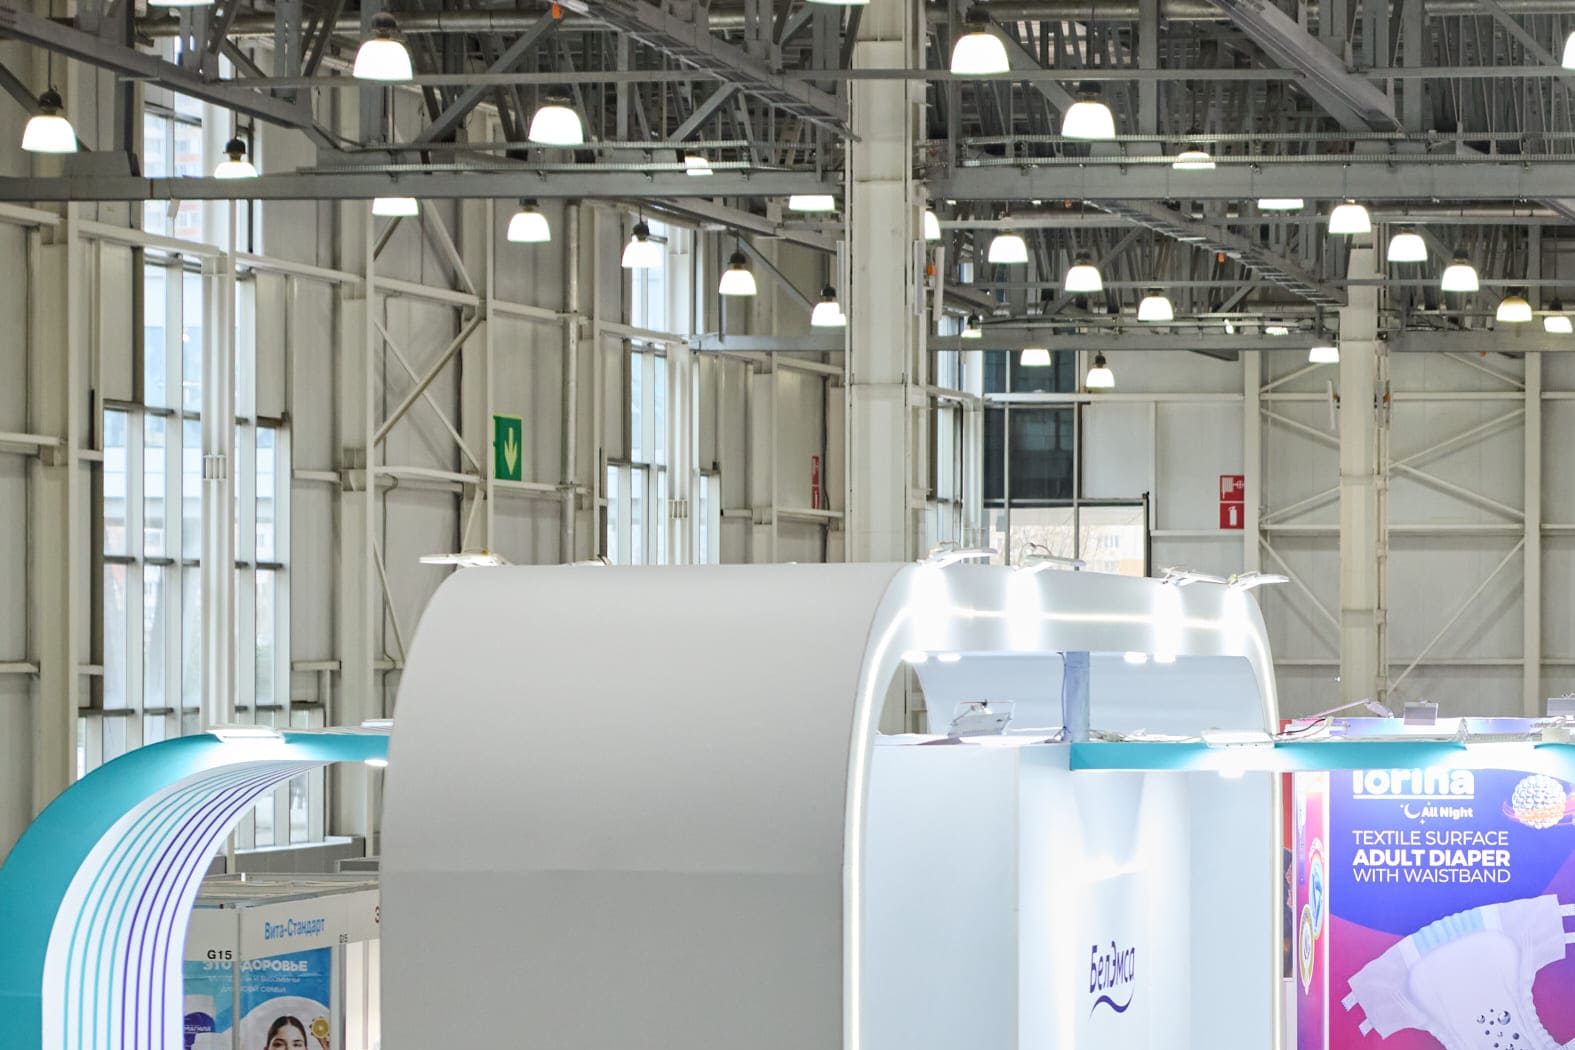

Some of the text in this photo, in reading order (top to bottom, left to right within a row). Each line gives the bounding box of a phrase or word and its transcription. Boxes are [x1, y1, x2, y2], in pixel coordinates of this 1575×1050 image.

[1421, 806, 1473, 819] All Night
[1352, 830, 1509, 846] TEXTILE SURFACE
[1352, 849, 1511, 867] ADULT DIAPER
[1353, 868, 1511, 883] WITH WAISTBAND
[264, 918, 326, 941] Вита-Стандарт
[207, 949, 233, 961] G15
[240, 960, 308, 972] ДОРОВЬЕ
[1089, 940, 1135, 994] БелЭмса
